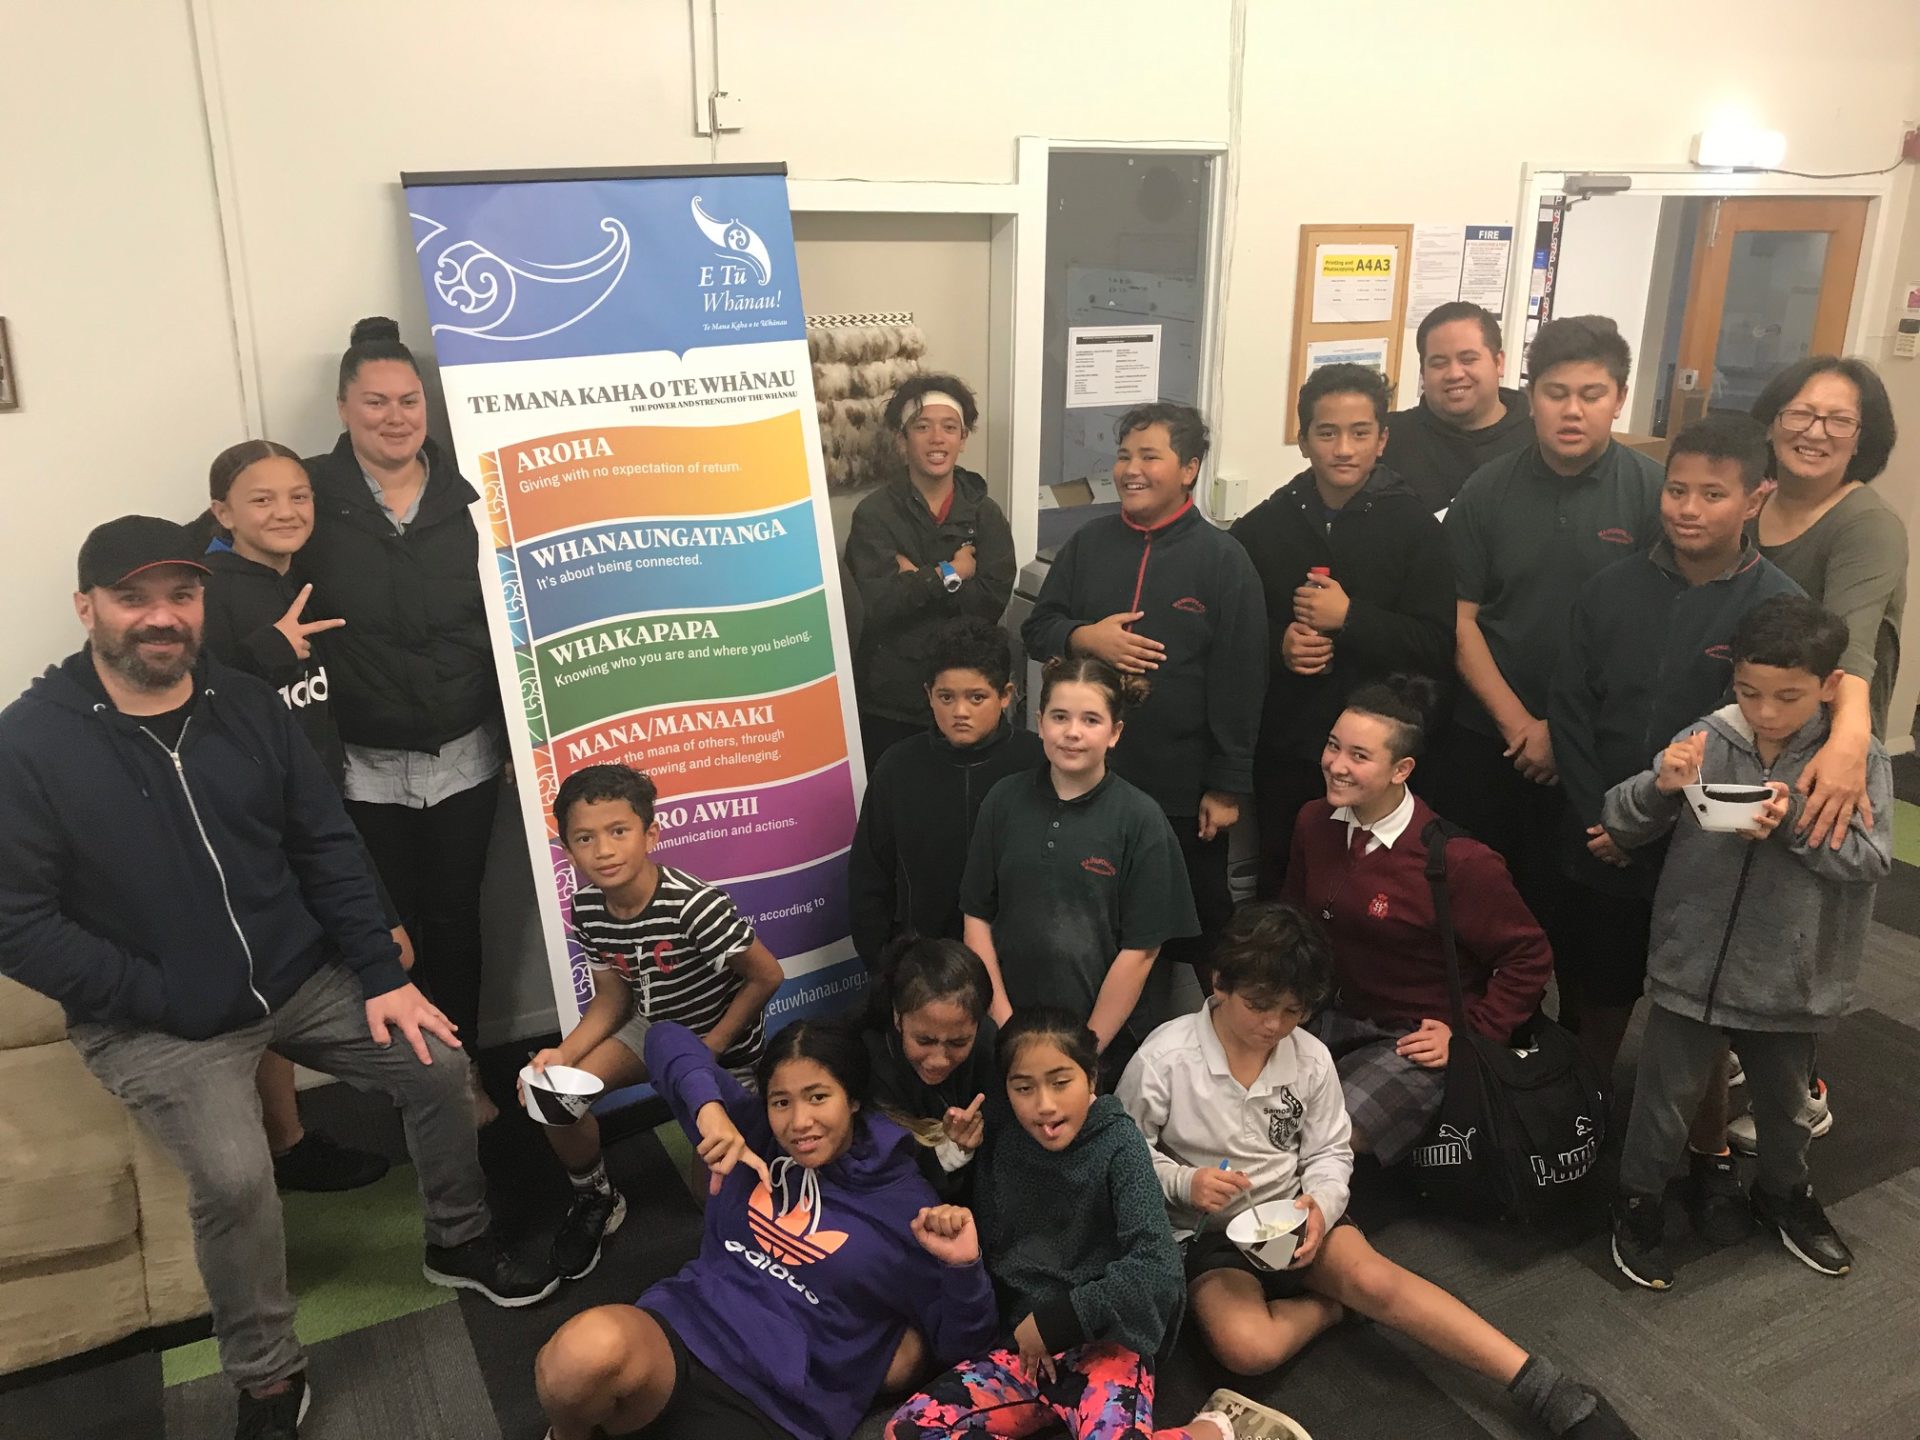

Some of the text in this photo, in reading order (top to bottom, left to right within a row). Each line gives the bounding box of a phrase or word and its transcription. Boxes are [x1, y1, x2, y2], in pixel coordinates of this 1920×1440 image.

[1478, 230, 1500, 240] FIRE
[698, 265, 747, 287] E Tū
[1356, 259, 1373, 271] A4
[1374, 259, 1391, 271] A3
[704, 290, 782, 312] Whānau!
[703, 323, 710, 331] Te
[731, 321, 748, 331] Kaha
[467, 370, 796, 414] TE MANA KAHA O TE WHĀNAU
[629, 390, 798, 413] THE POWER AND STRENGTH OF THE WHĀNAU
[517, 436, 615, 473] AROHA
[519, 461, 742, 494] Giving with no expectation of return.
[530, 518, 788, 569] WHANAUNGATANGA
[537, 554, 703, 591] It's about being connected.
[548, 619, 720, 666] WHAKAPAPA
[554, 630, 812, 688] Knowing who you are and where you belong.
[566, 705, 775, 763] MANA/MANAAKI
[624, 752, 644, 765] the
[647, 745, 680, 760] mana
[683, 739, 695, 751] of
[698, 735, 738, 749] others,
[741, 728, 785, 744] through
[689, 756, 712, 770] and
[714, 748, 783, 767] challenging.
[654, 796, 760, 831] RO AWHI
[731, 822, 752, 836] and
[755, 817, 798, 832] actions.
[760, 900, 813, 922] according
[814, 897, 825, 908] to
